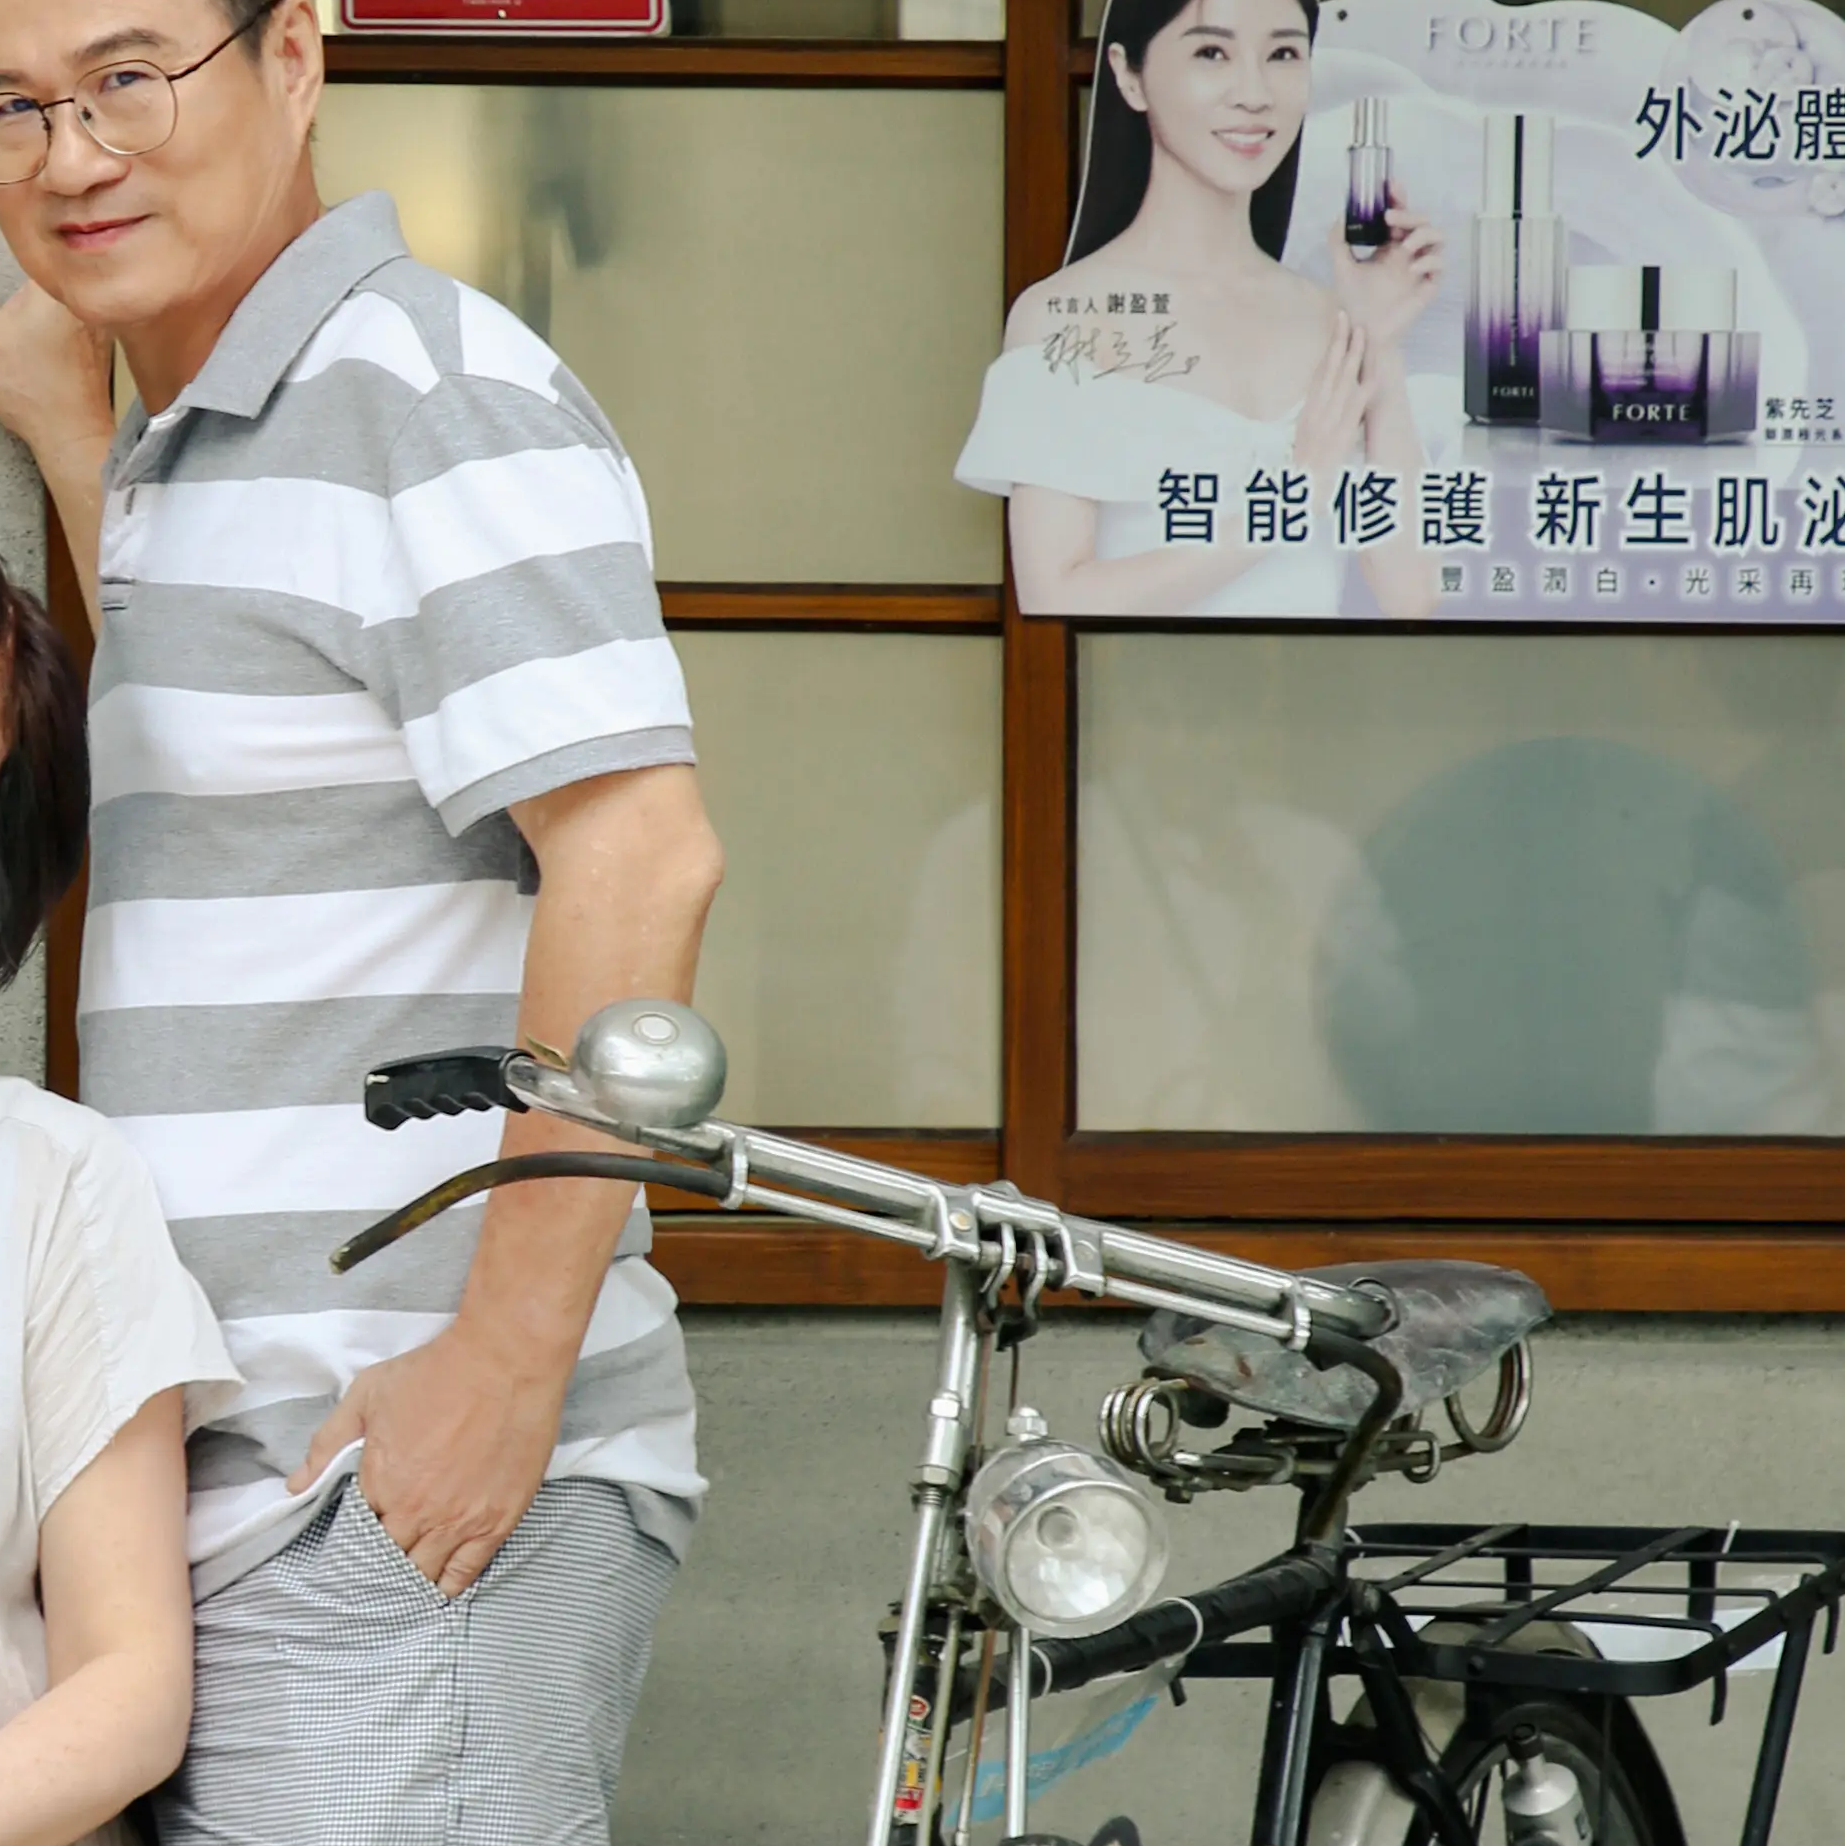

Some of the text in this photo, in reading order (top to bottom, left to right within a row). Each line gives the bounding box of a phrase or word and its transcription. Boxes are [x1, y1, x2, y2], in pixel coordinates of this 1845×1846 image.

[1425, 15, 1599, 55] FORTE
[1047, 296, 1100, 315] 代言人
[1612, 403, 1691, 422] FORTE
[1765, 397, 1836, 420] 紫先芝
[1158, 467, 1487, 547] 智能修護
[1440, 566, 1845, 595] 豐盈潤白・光采再
